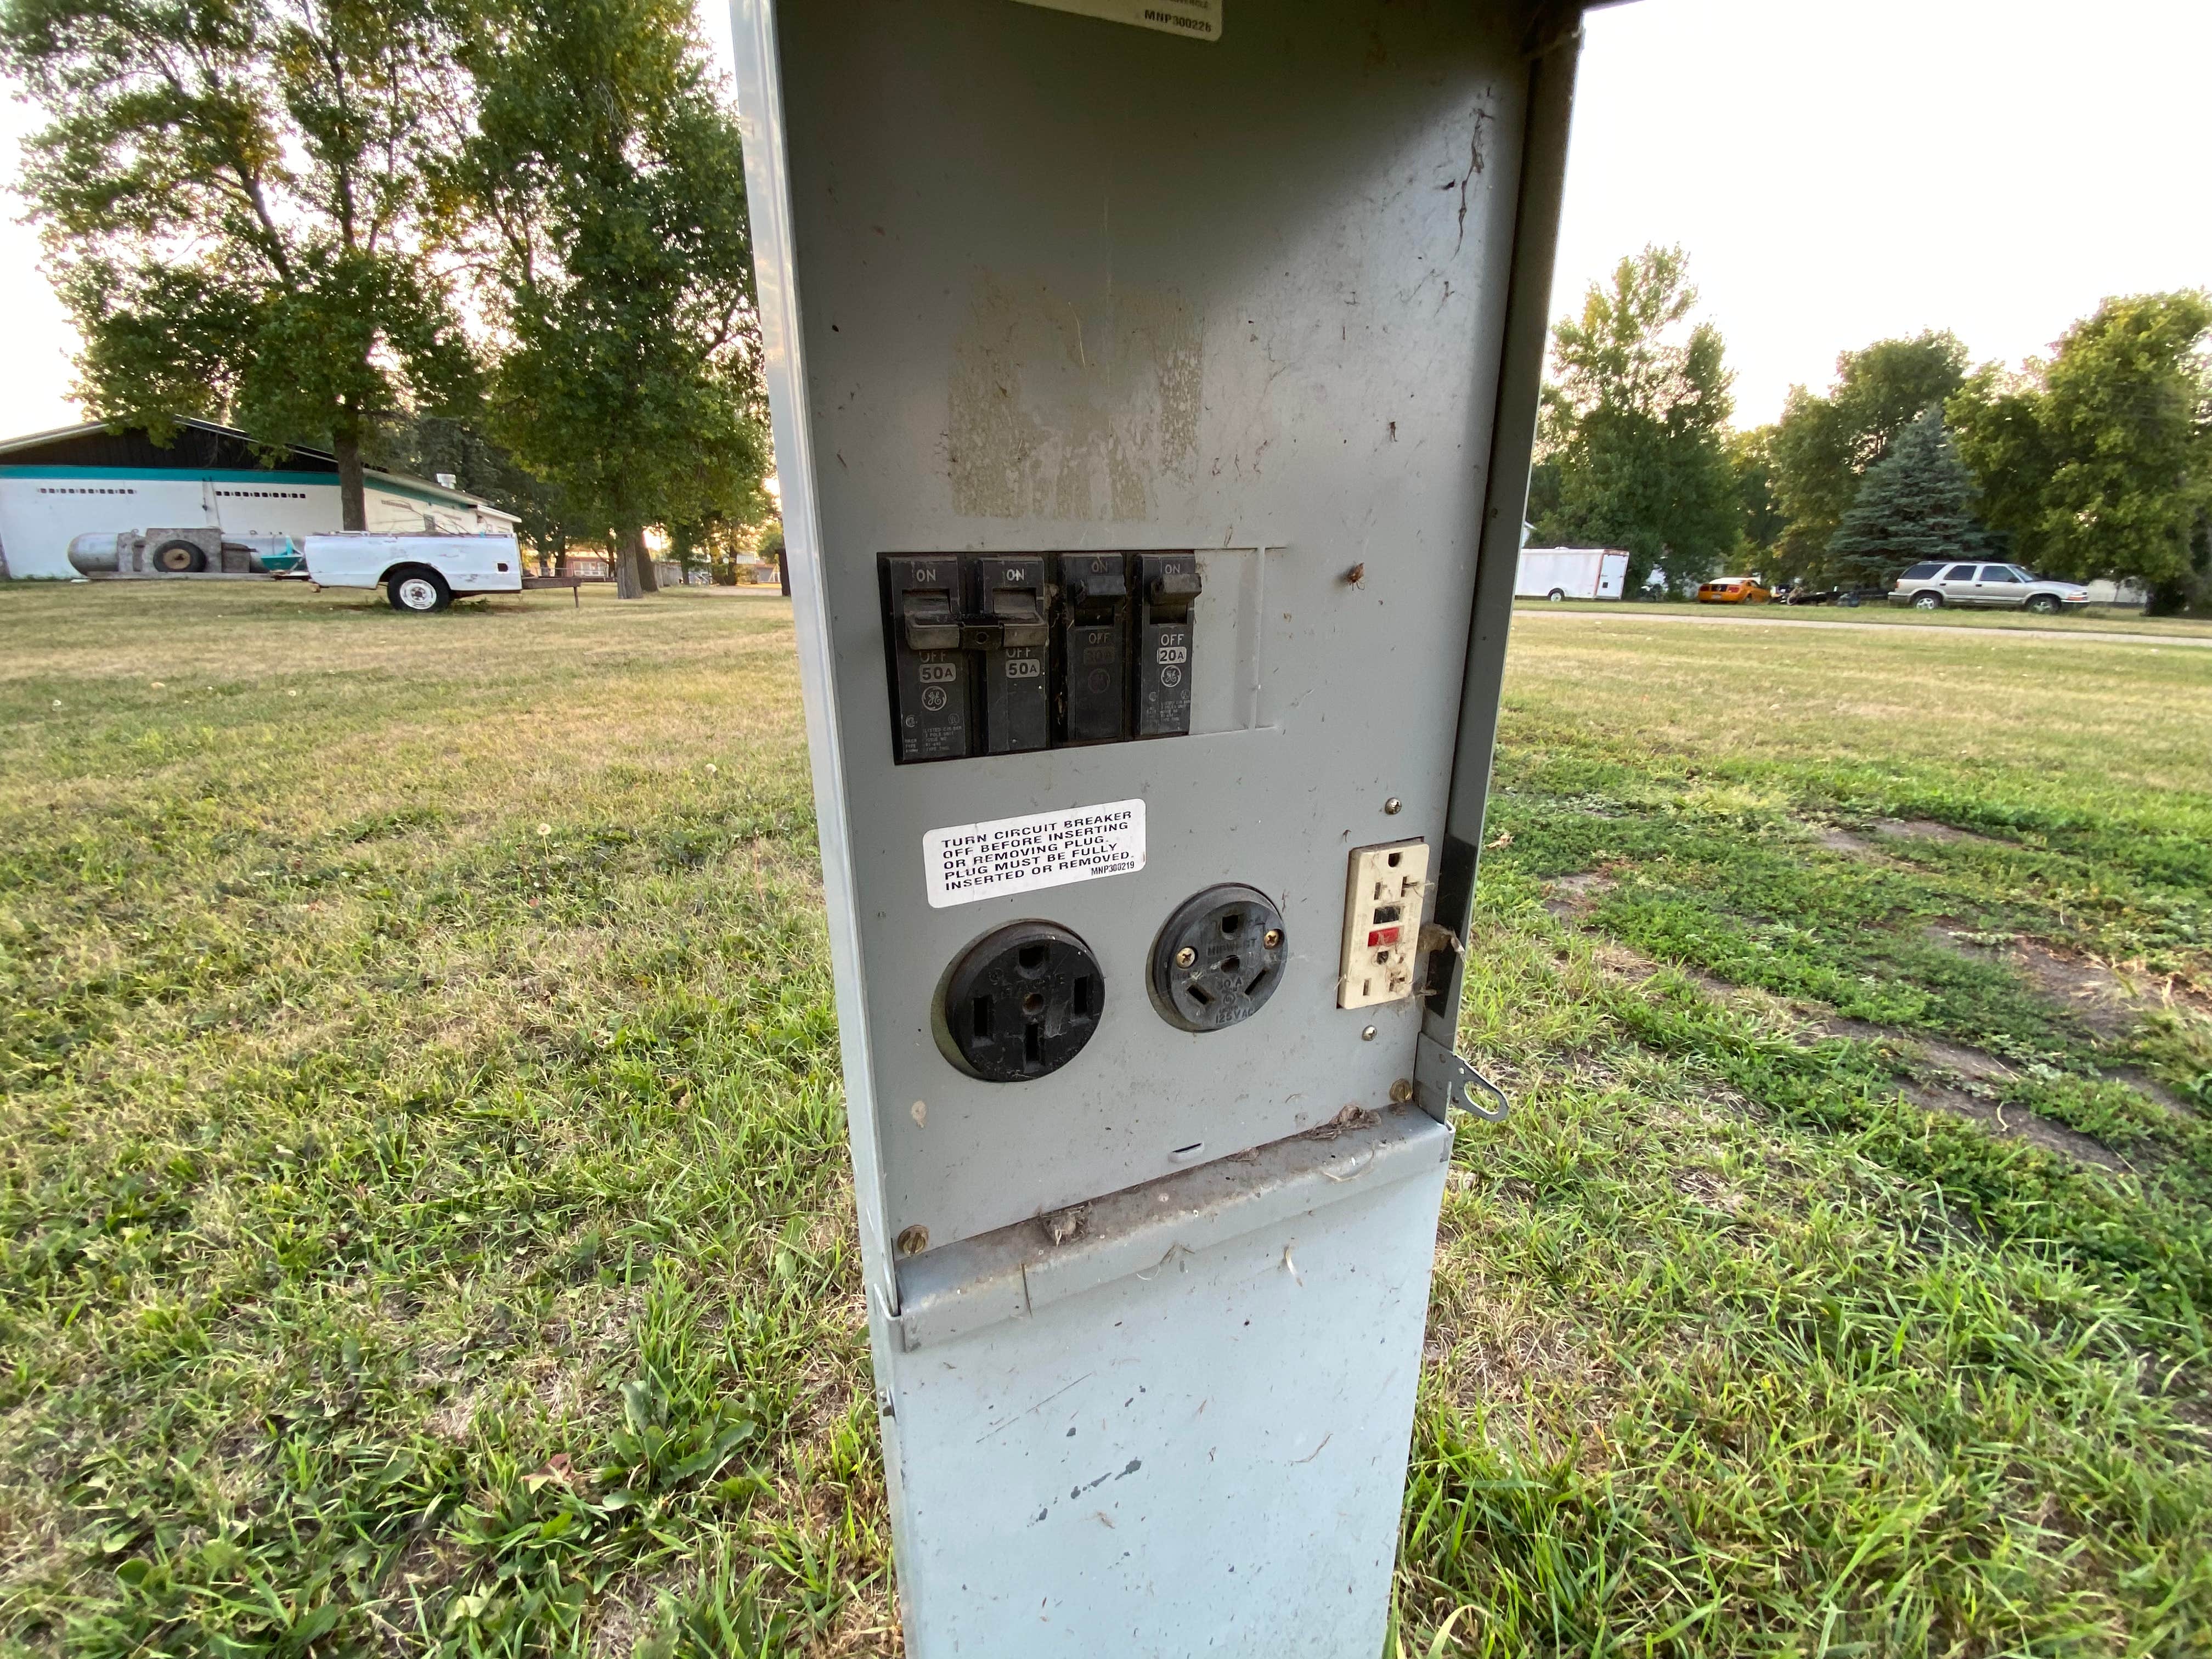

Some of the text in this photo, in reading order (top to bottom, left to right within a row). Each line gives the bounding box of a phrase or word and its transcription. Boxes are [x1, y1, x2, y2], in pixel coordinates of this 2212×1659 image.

[1091, 561, 1108, 573] ON
[1165, 564, 1181, 574] ON
[916, 568, 936, 582] ON
[1006, 568, 1025, 582] ON
[1089, 633, 1110, 645] OFF
[1161, 634, 1184, 646] OFF
[1006, 647, 1031, 658] OFF
[1159, 650, 1184, 662] 20A
[922, 667, 953, 680] 50A
[1008, 662, 1037, 675] 50A
[942, 811, 1131, 848] TURN CIRCUIT BREAKER
[943, 822, 1128, 859] OFF BEFORE INSERTING
[944, 836, 1109, 869] OR REMOVING PLUG.
[945, 843, 1117, 880] PLUG MUST BE FULLY
[946, 851, 1134, 890] INSERTED OR REMOVED.
[1091, 861, 1135, 876] MNP300219
